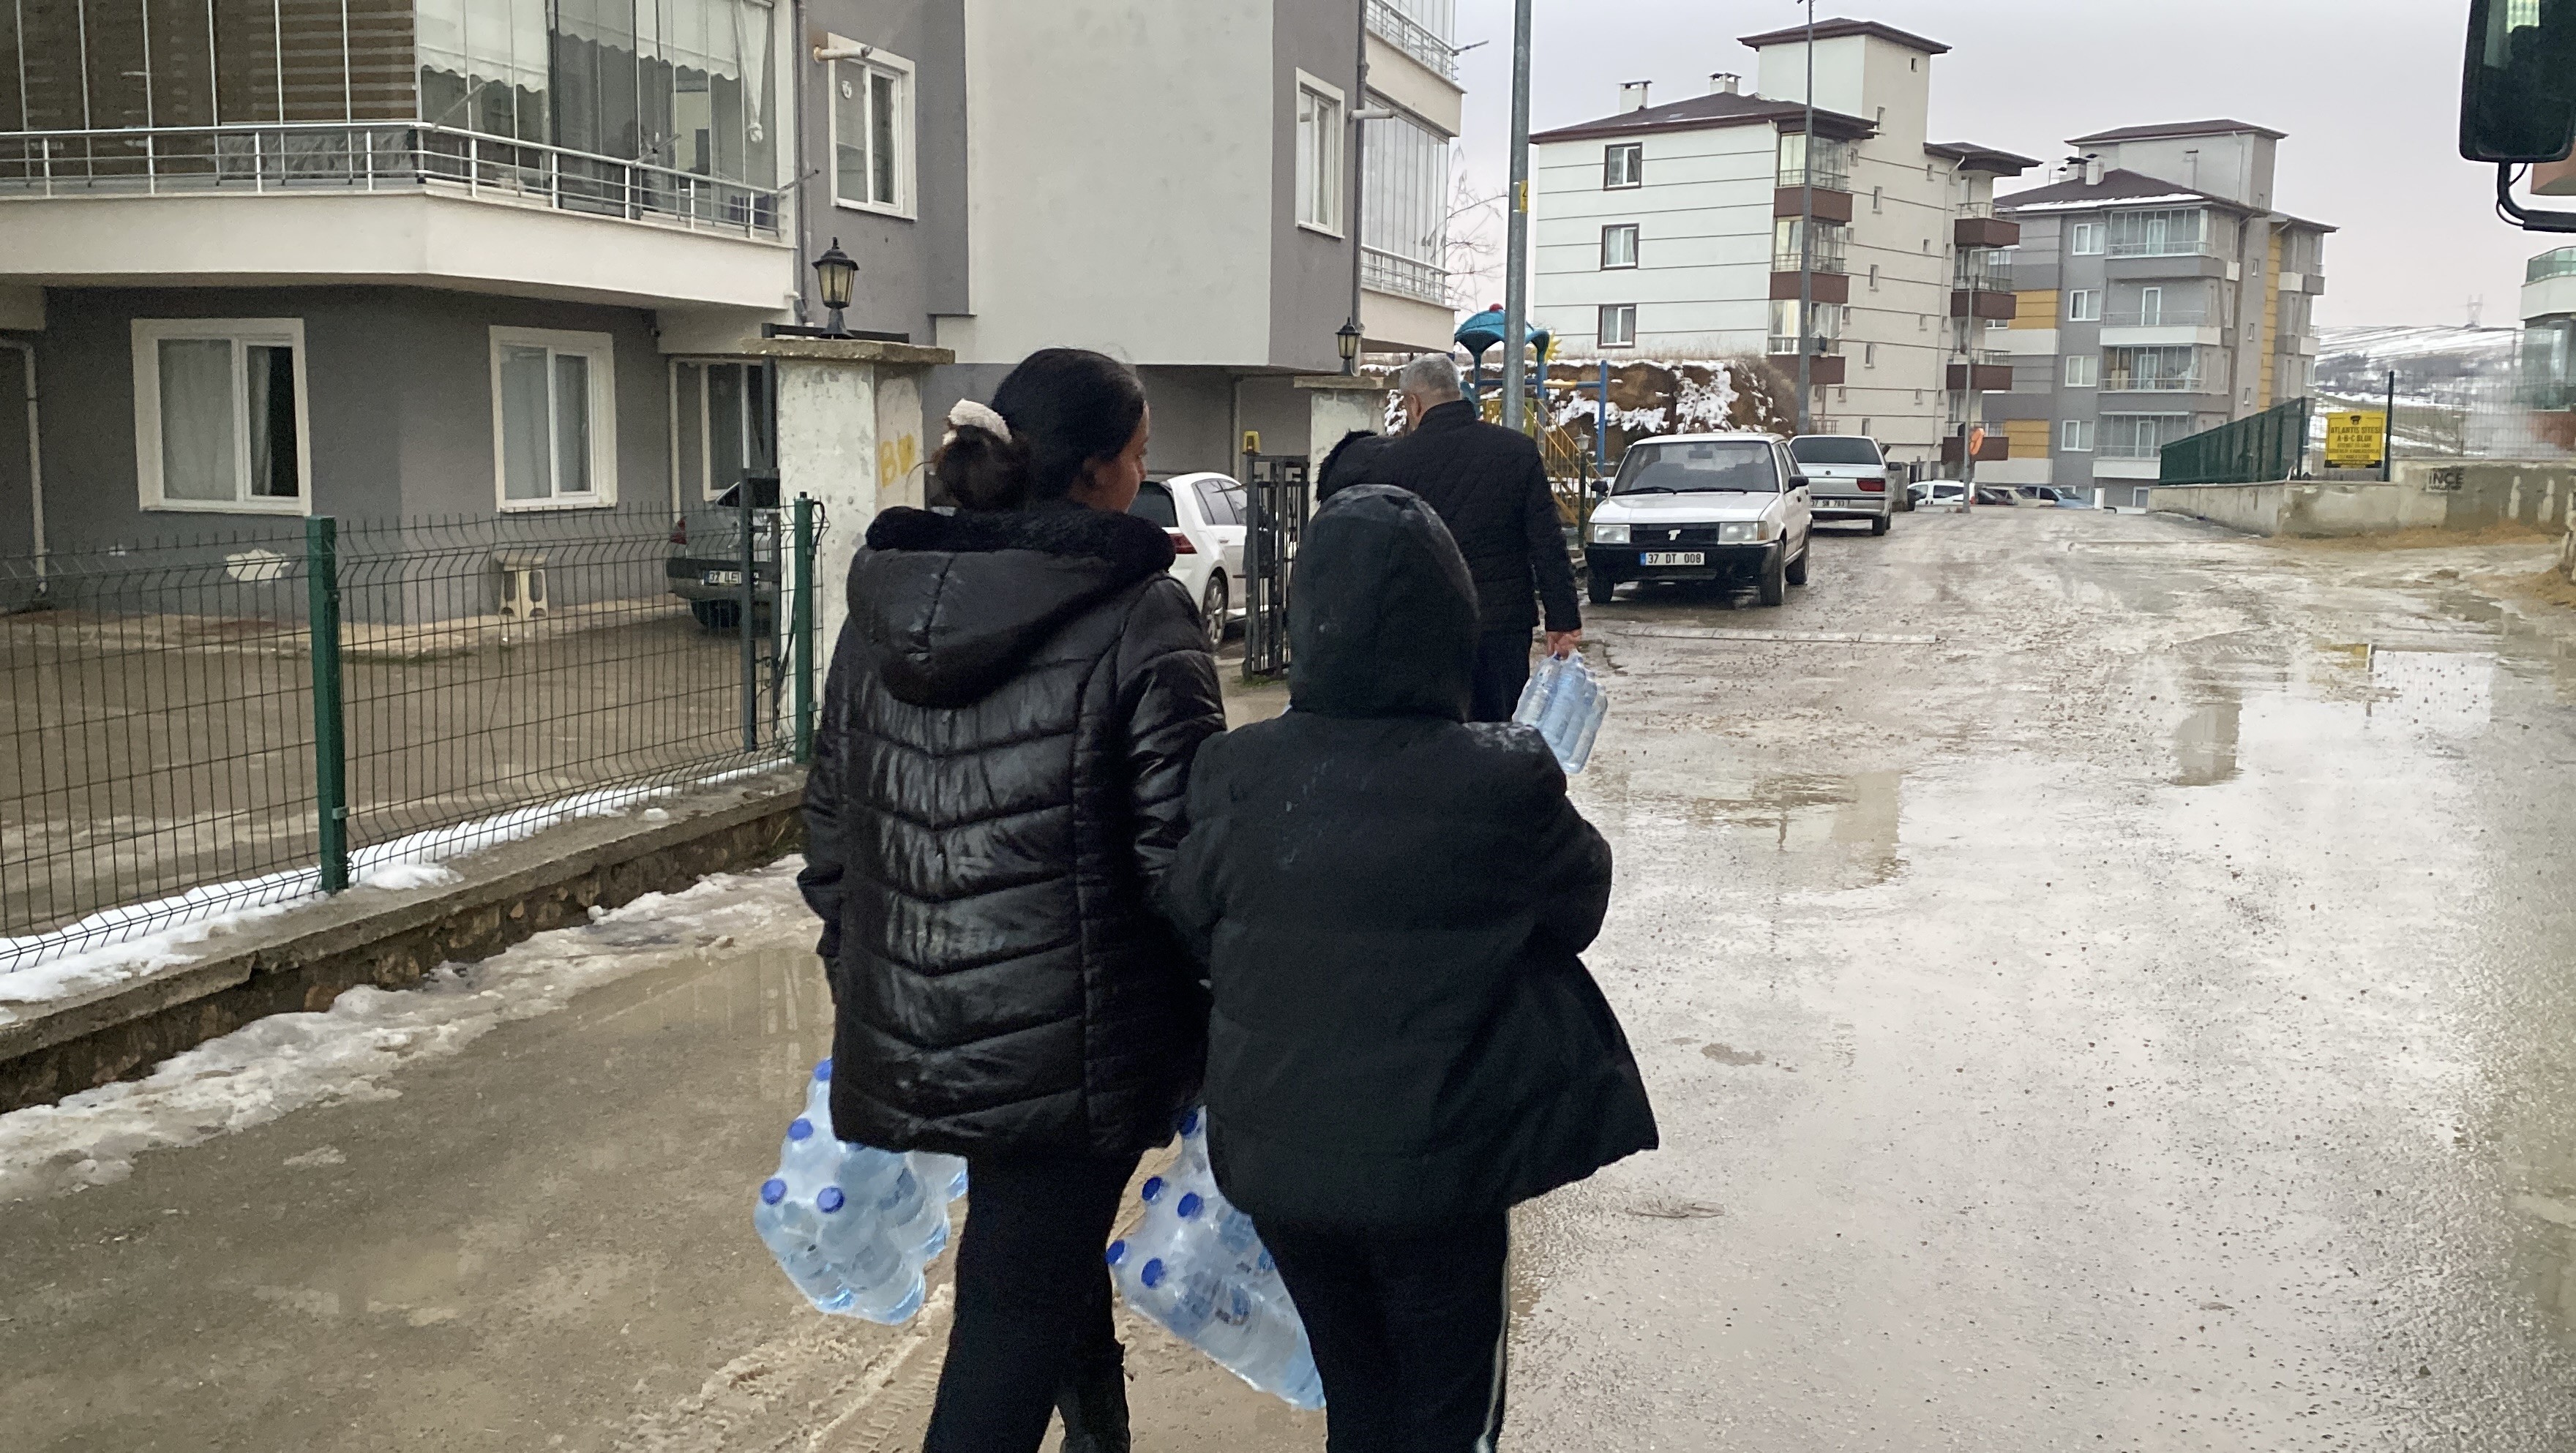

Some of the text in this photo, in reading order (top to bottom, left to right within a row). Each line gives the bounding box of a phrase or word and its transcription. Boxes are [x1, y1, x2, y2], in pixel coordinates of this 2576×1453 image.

[1648, 553, 1701, 564] 37 DT 008
